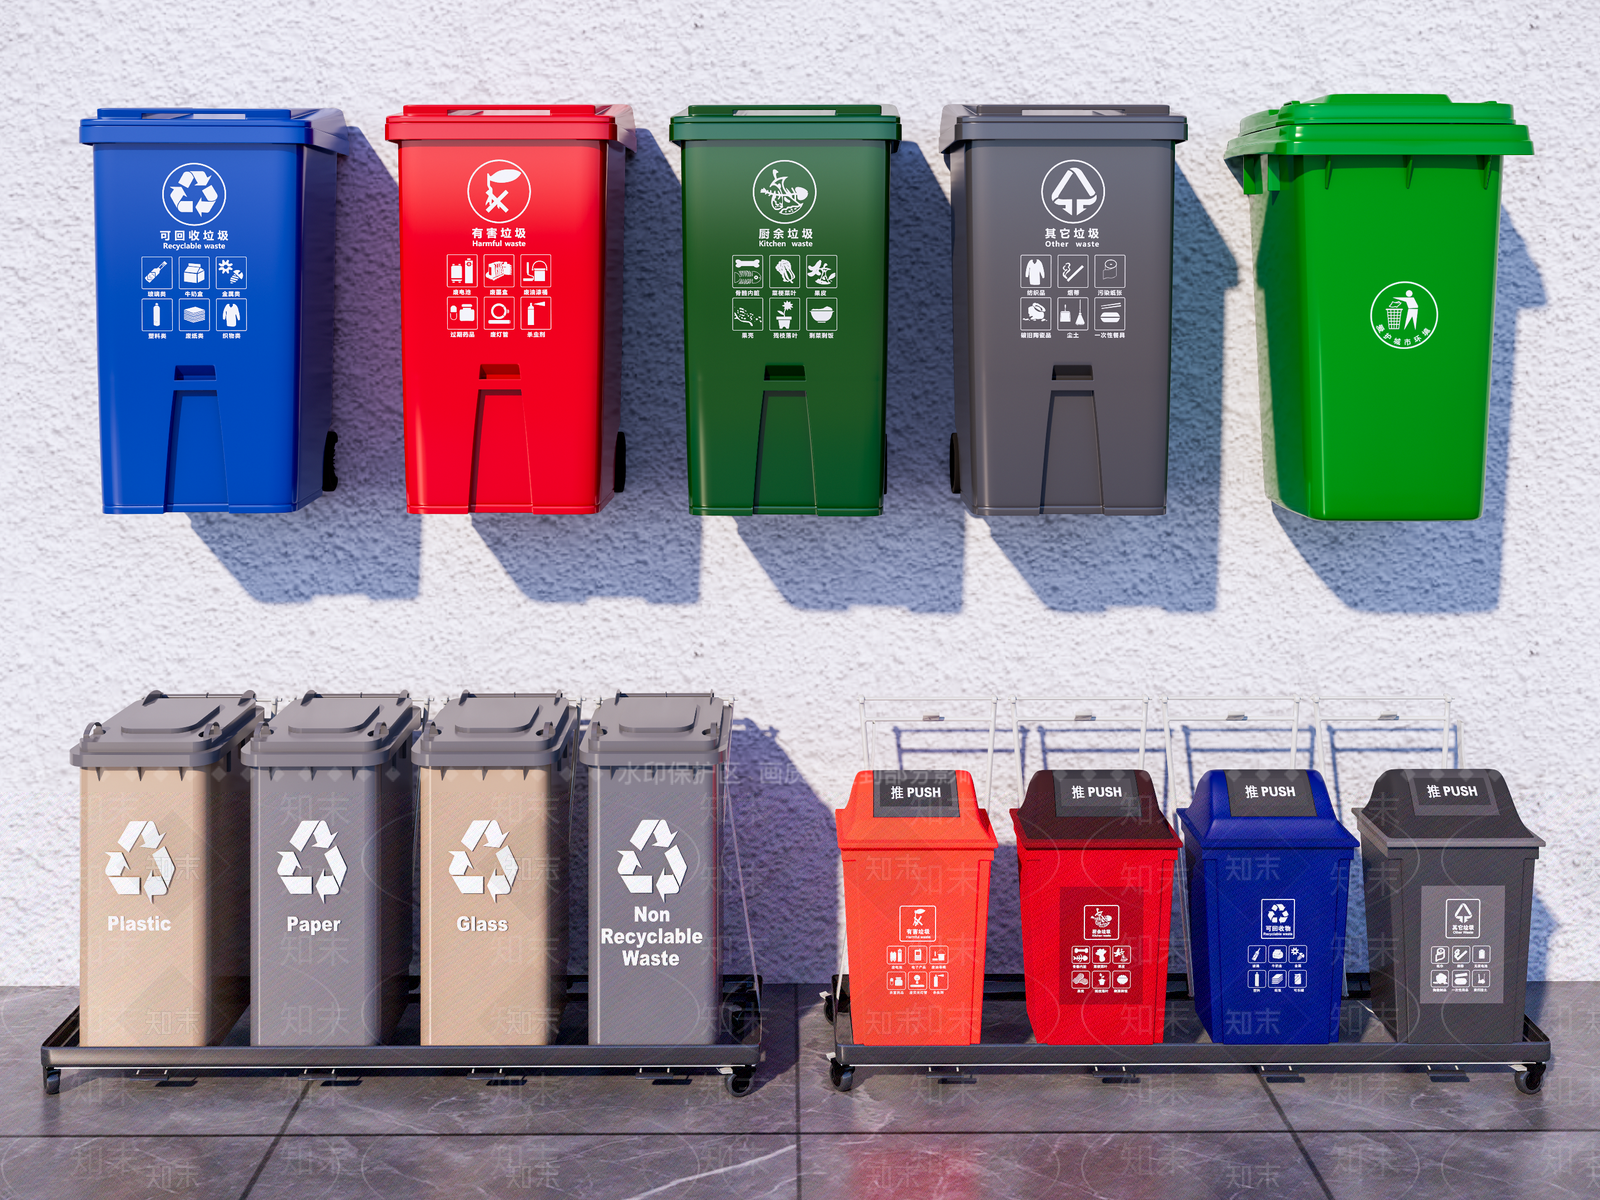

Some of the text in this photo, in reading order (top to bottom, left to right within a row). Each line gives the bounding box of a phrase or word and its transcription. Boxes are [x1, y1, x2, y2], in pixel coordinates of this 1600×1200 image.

[160, 230, 228, 241] 可回收垃圾
[472, 228, 525, 238] 有害垃圾
[759, 228, 812, 239] 厨余垃圾
[1045, 228, 1099, 239] 其它垃圾
[1376, 324, 1431, 346] 爱护城市环境
[891, 786, 941, 799] 推 PUSH
[1072, 786, 1122, 799] 推 PUSH
[1245, 785, 1295, 798] 推 PUSH
[1427, 785, 1477, 798] 推 PUSH
[635, 906, 669, 922] Non
[108, 916, 171, 931] Plastic
[288, 917, 340, 935] Paper
[457, 916, 507, 931] Glass
[602, 928, 702, 946] Recyclable
[622, 950, 679, 966] Waste
